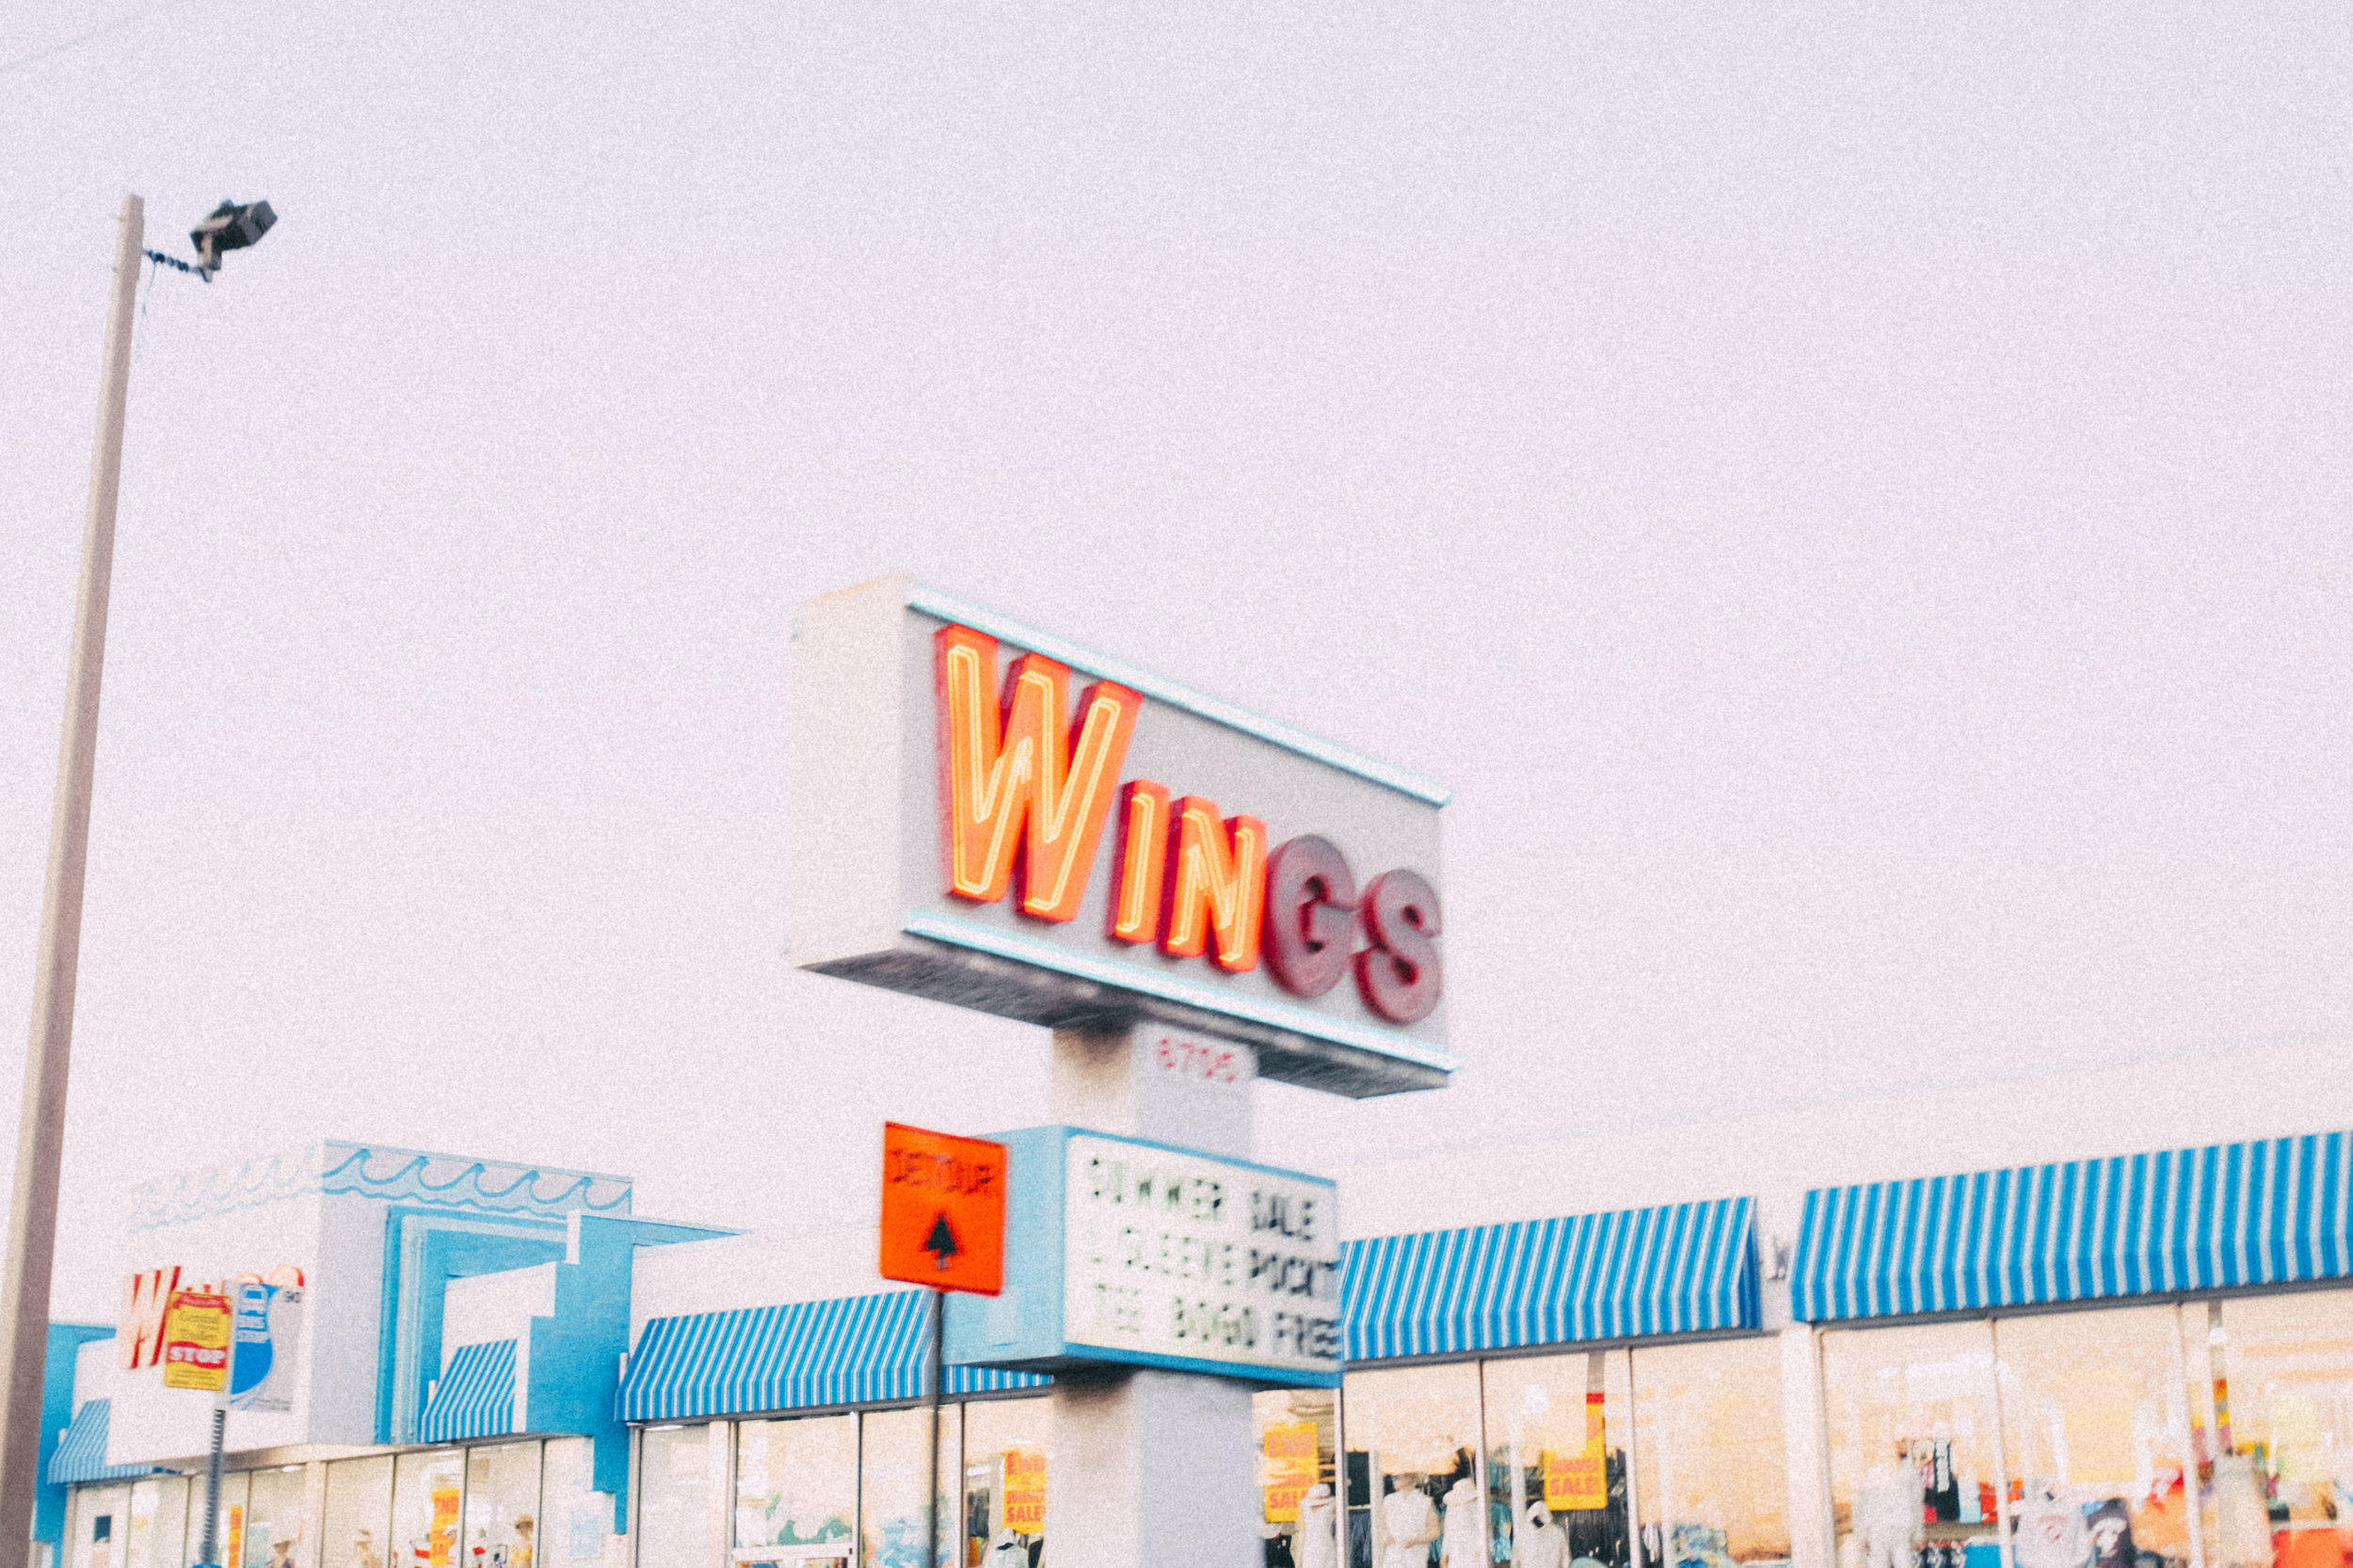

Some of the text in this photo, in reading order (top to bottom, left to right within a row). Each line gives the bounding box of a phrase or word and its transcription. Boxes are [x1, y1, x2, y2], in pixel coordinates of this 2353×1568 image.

[933, 622, 1442, 1024] WINGS
[1251, 1189, 1316, 1242] SALE
[169, 1346, 226, 1364] STOP
